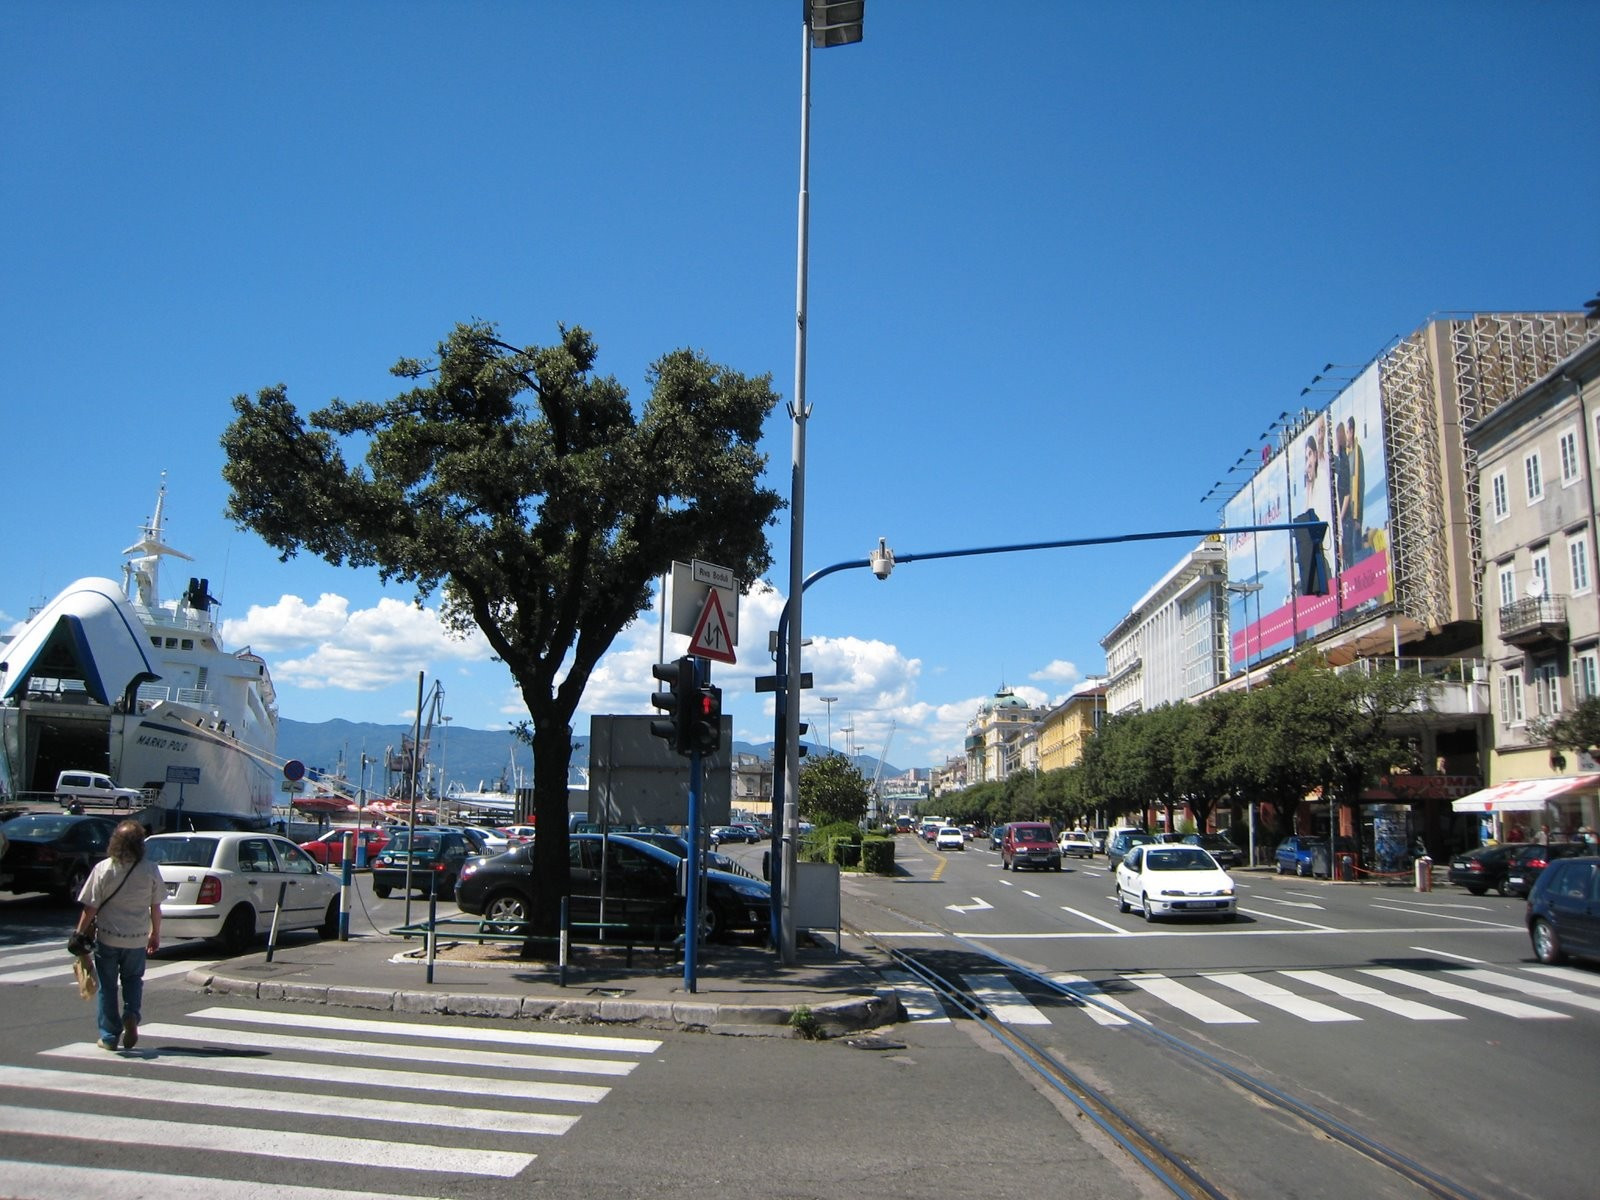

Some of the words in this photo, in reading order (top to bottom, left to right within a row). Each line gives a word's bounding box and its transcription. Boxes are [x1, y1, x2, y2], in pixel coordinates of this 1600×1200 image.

[699, 567, 711, 578] Riva
[136, 735, 168, 749] MARKO
[168, 740, 188, 752] POLO
